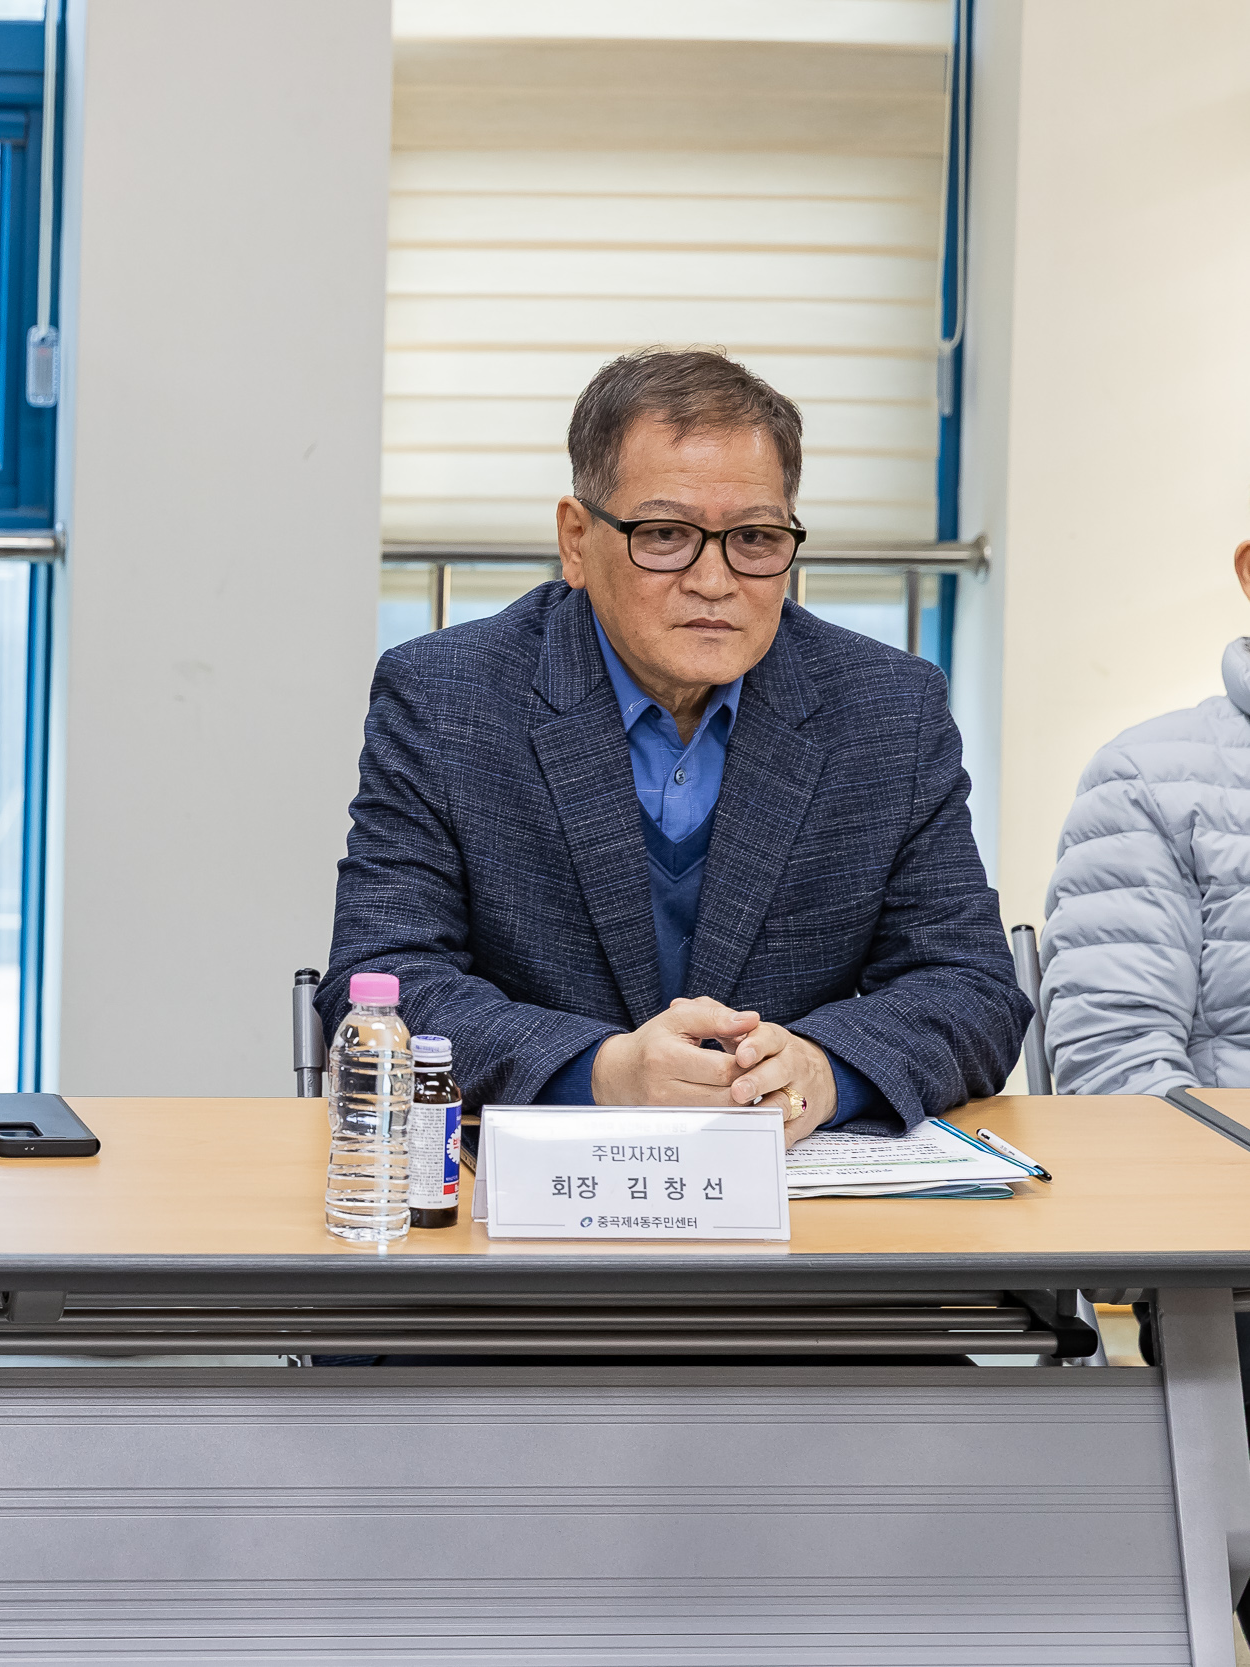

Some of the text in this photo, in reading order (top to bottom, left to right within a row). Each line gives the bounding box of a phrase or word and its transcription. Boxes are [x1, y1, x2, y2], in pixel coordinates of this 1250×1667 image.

[591, 1145, 680, 1163] 주민자치회
[551, 1175, 599, 1200] 회장
[597, 1215, 698, 1229] 중곡제4동주민센터
